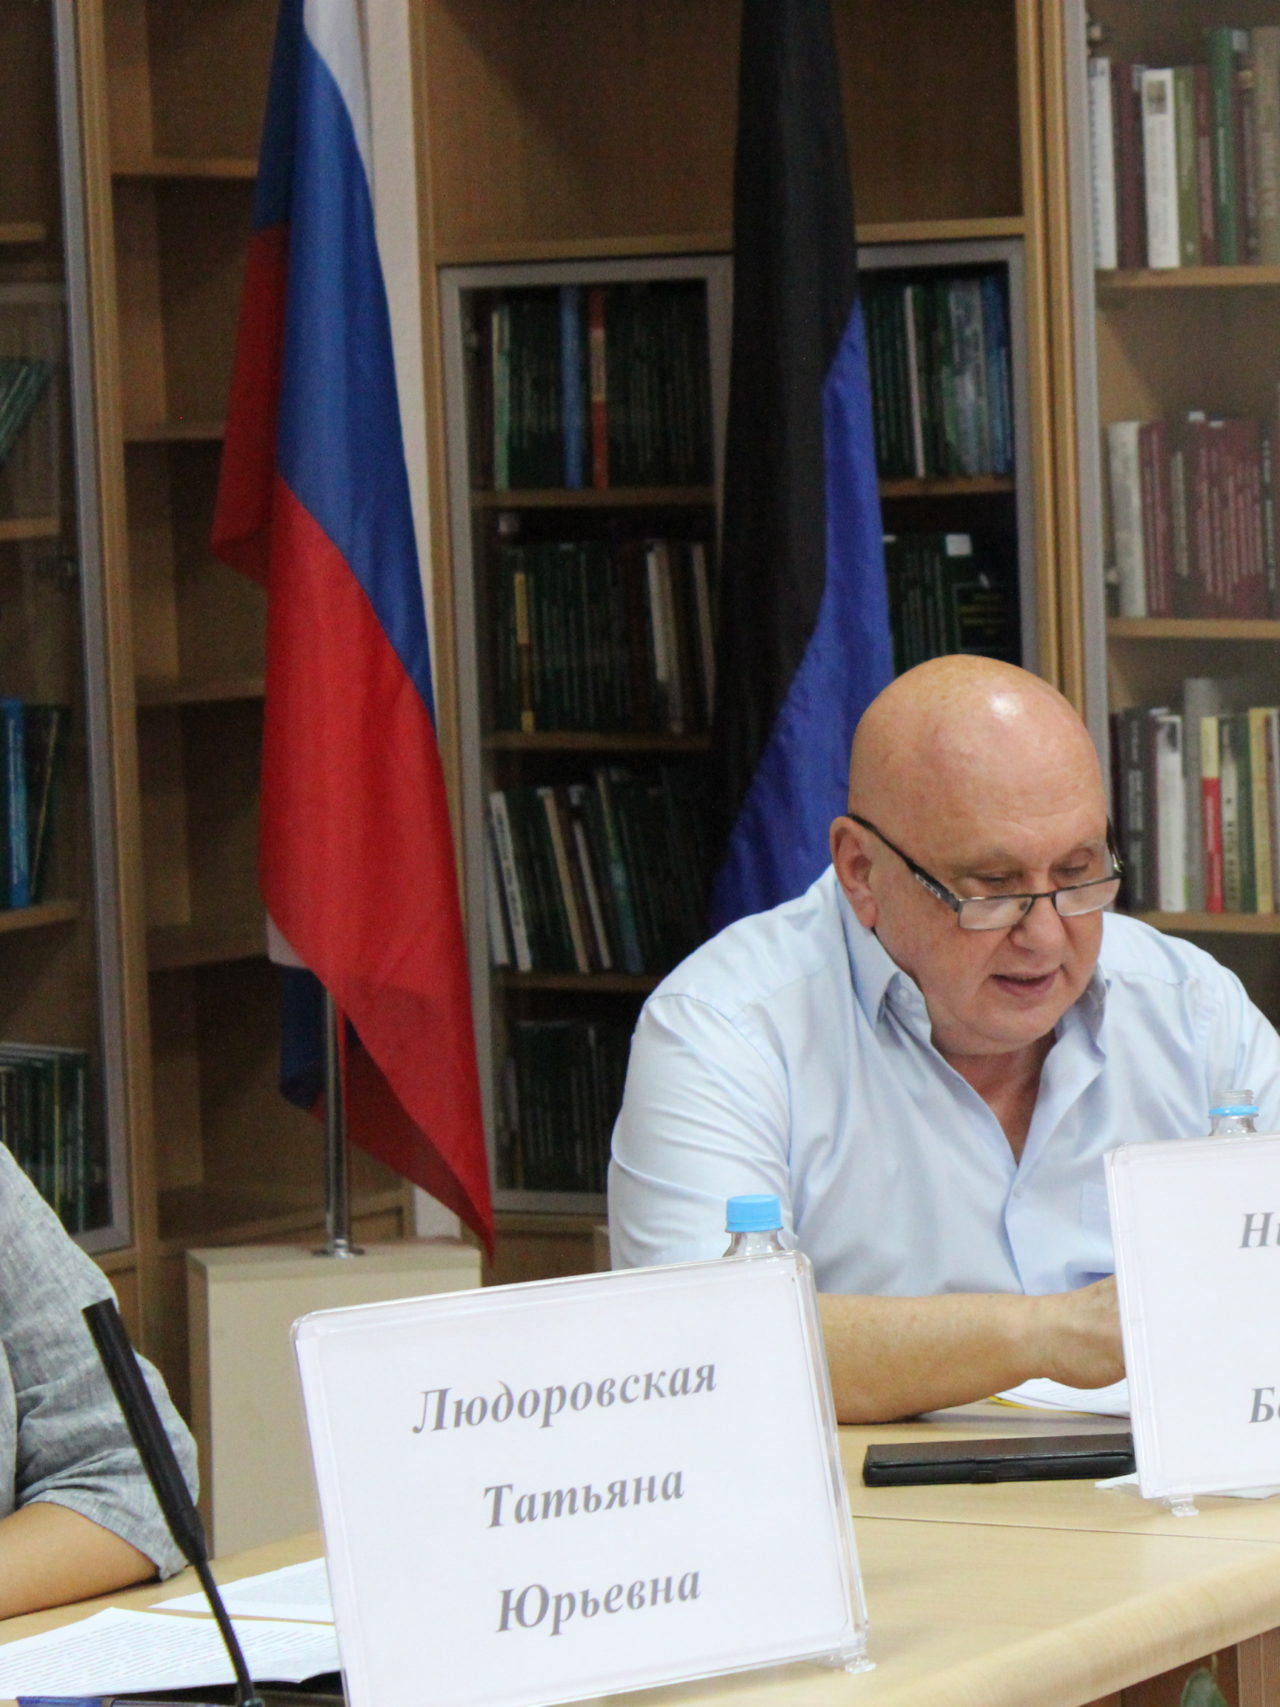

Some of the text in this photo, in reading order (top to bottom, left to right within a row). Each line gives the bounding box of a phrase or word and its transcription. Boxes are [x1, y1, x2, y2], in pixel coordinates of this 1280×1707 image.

[411, 1363, 718, 1434] Людоровская
[482, 1470, 686, 1529] Татьяна
[495, 1570, 702, 1637] Юрьевна
